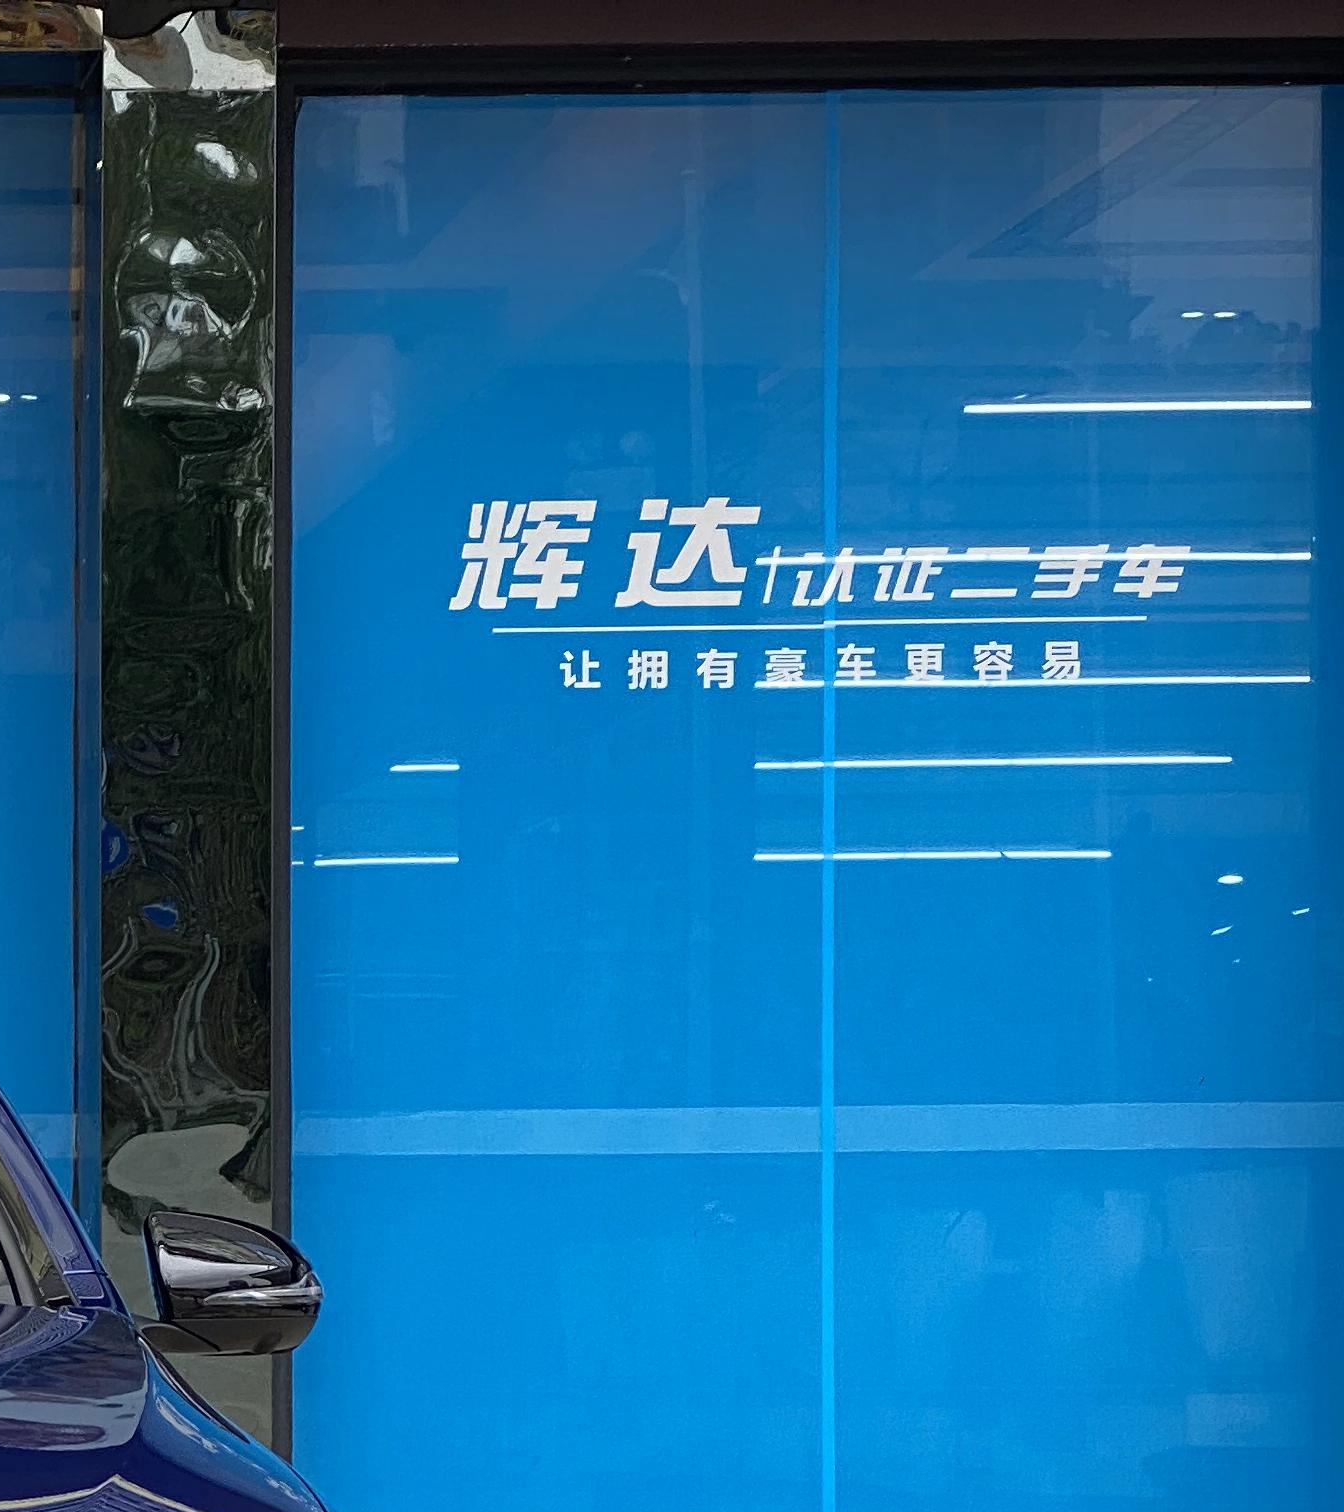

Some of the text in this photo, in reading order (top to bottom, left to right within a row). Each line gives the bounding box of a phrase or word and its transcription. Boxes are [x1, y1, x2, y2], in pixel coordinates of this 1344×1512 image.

[450, 498, 761, 610] 辉达
[559, 641, 1084, 690] 让拥有豪车更容易
